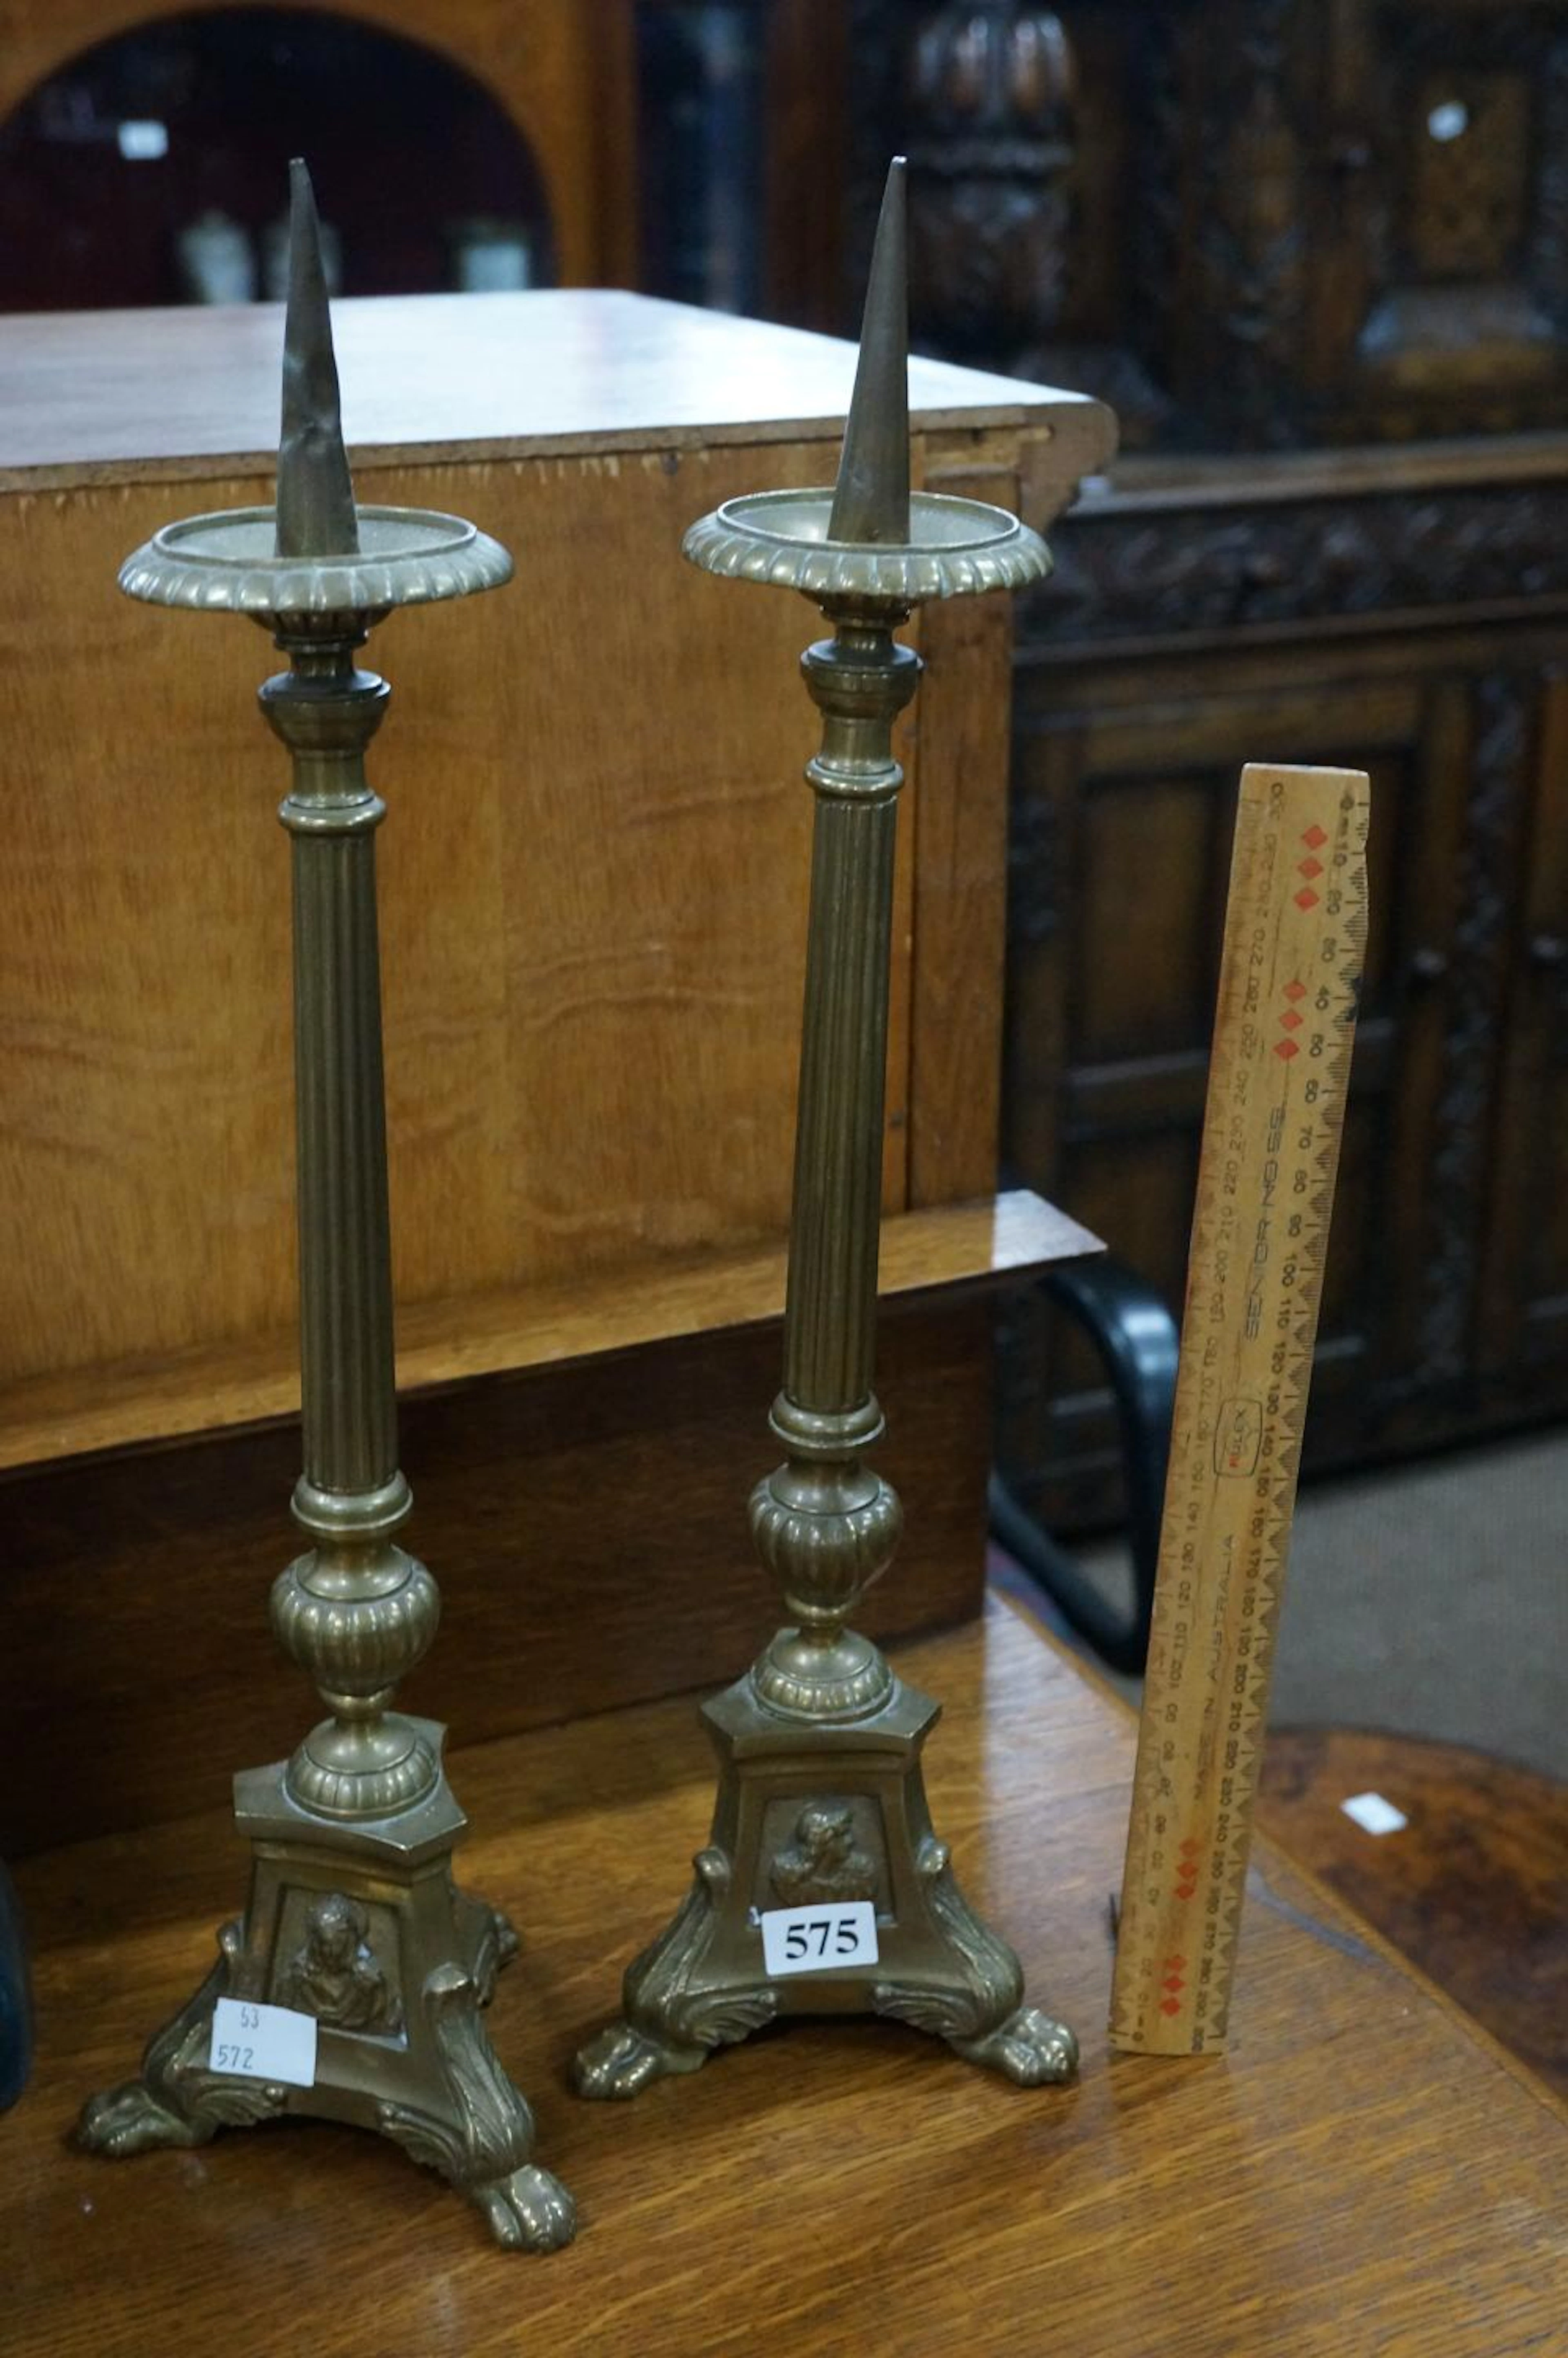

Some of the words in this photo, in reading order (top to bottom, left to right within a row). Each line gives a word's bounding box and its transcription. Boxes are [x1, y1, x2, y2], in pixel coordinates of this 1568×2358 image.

[1207, 1535, 1234, 1682] AUSTRALIA
[786, 1919, 859, 1959] 575
[218, 2044, 254, 2069] 572
